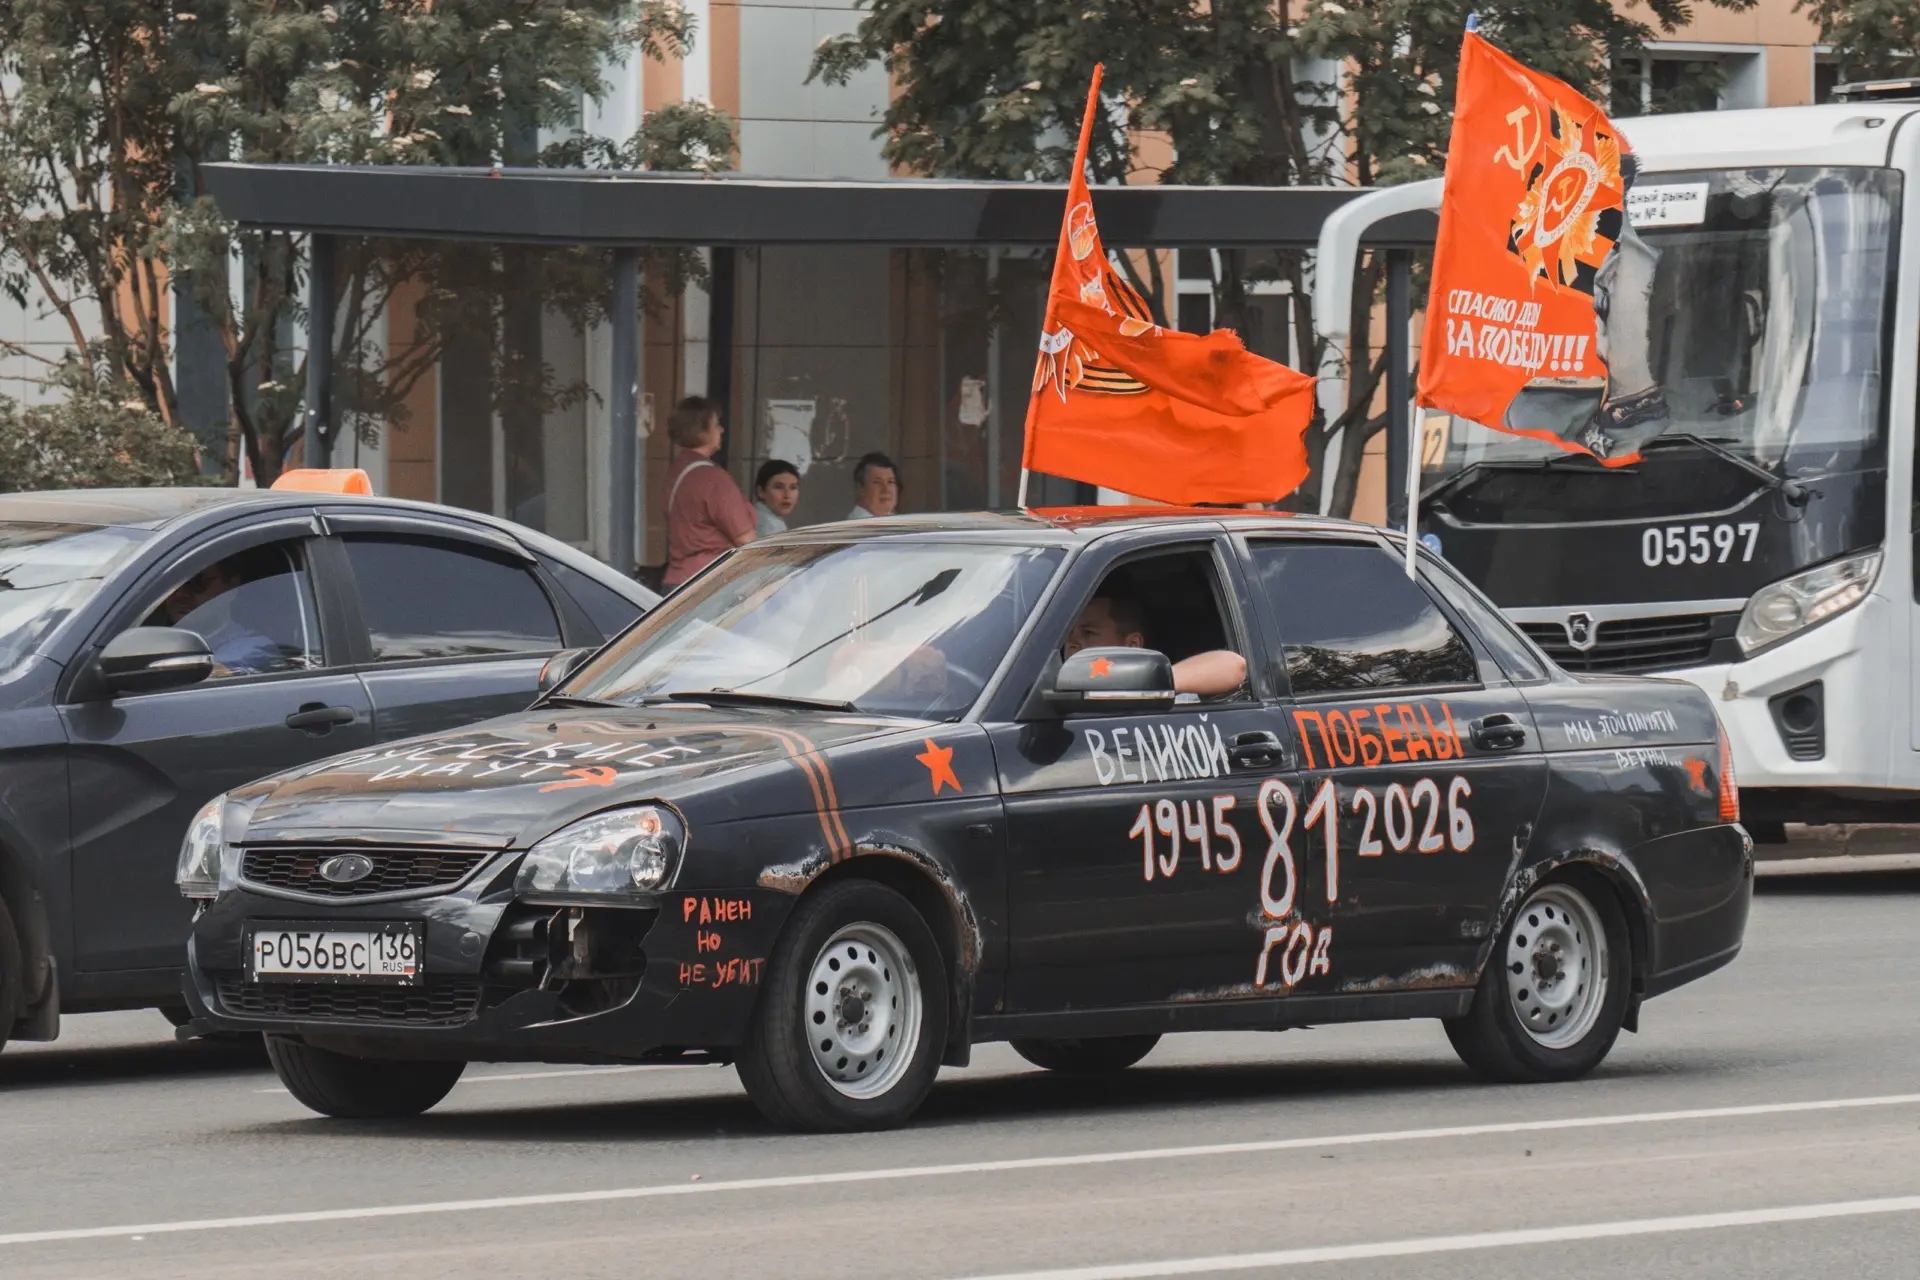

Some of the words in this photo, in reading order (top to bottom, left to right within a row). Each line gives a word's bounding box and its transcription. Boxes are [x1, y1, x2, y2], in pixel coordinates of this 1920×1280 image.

[1629, 189, 1658, 205] дный
[1661, 191, 1698, 205] рынок
[1448, 289, 1517, 325] СПАСИБО
[1478, 327, 1590, 377] ПОБЕДУ!!!
[1642, 522, 1760, 567] 05597
[1085, 713, 1231, 786] ВЕЛИКОЙ
[1293, 702, 1464, 770] ПОБЕДЫ
[1563, 719, 1597, 744] МЫ
[307, 742, 702, 775] РУССКИЕ
[1129, 794, 1243, 881] 1945
[1256, 777, 1339, 919] 81
[1353, 774, 1475, 857] 2026
[683, 896, 751, 925] РАНЕН
[373, 931, 414, 961] 136
[697, 929, 721, 954] НО
[1254, 920, 1333, 988] ГОД
[382, 961, 403, 973] RUS
[680, 962, 706, 986] НЕ
[712, 957, 765, 988] УБИТ
